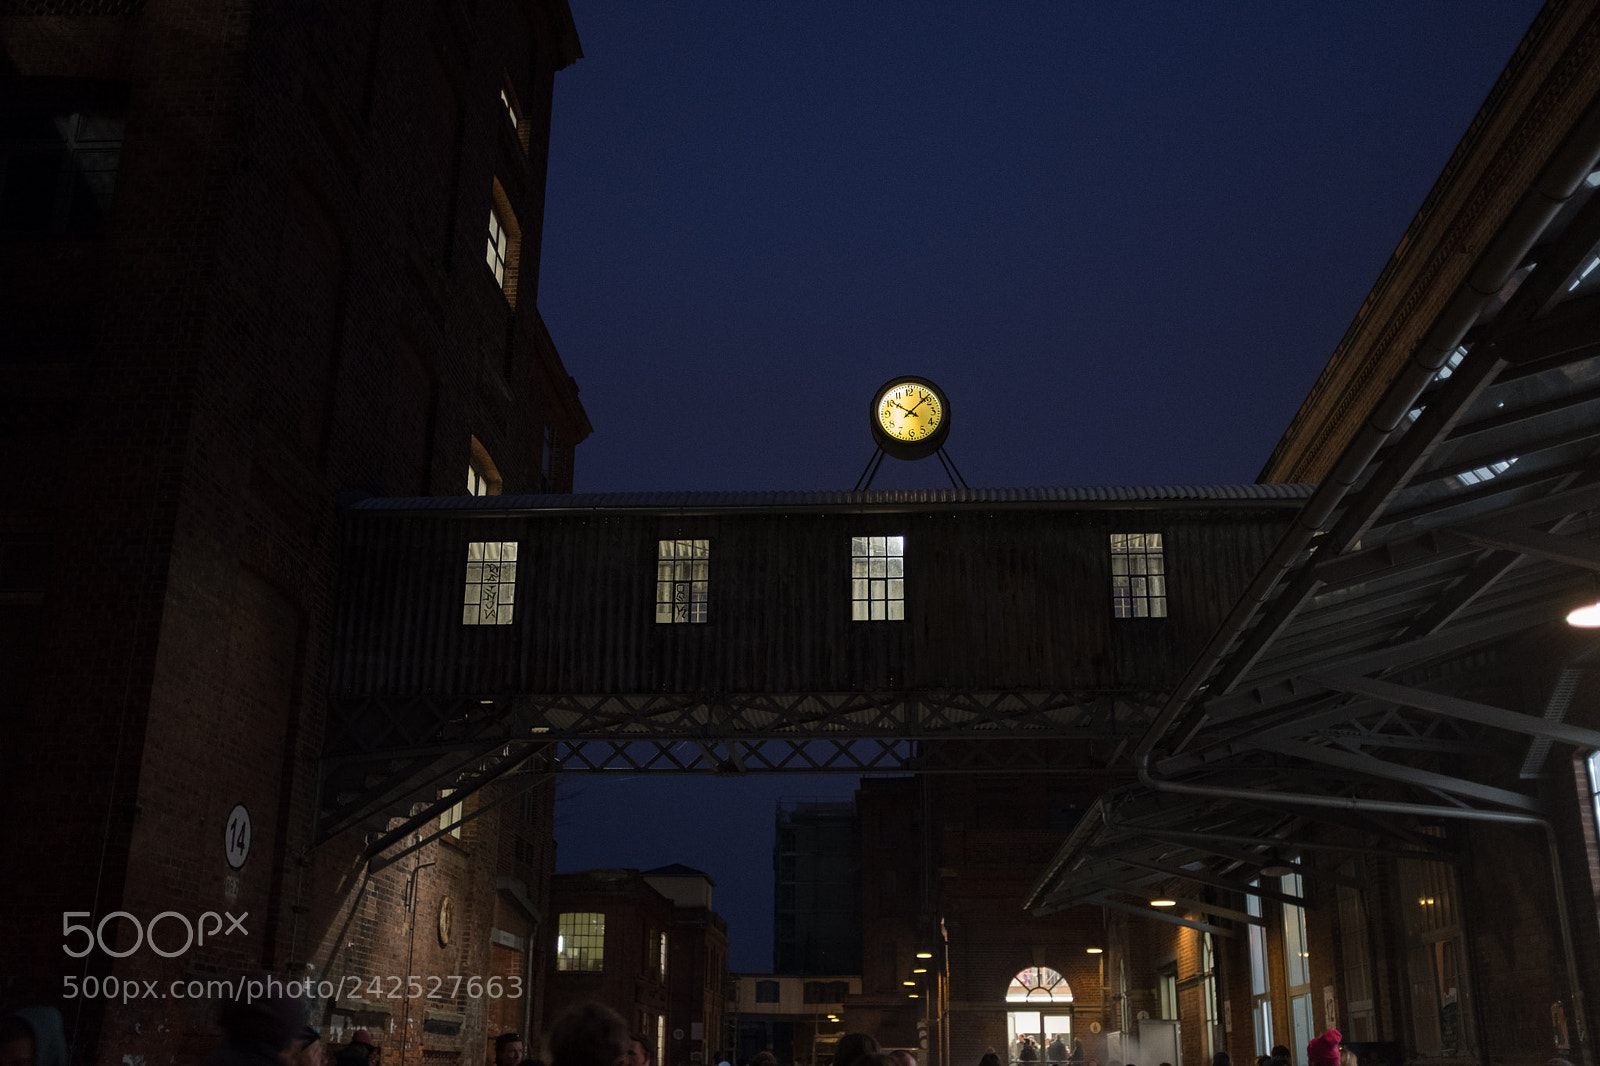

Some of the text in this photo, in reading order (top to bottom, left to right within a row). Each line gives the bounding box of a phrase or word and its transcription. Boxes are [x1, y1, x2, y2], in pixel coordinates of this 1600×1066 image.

[926, 397, 932, 406] 2
[884, 410, 891, 418] 9
[930, 407, 936, 416] 3
[889, 420, 895, 428] 8
[928, 418, 934, 426] 4
[898, 427, 903, 435] 7
[908, 429, 915, 437] 6
[920, 426, 926, 434] 5
[230, 817, 246, 856] 14
